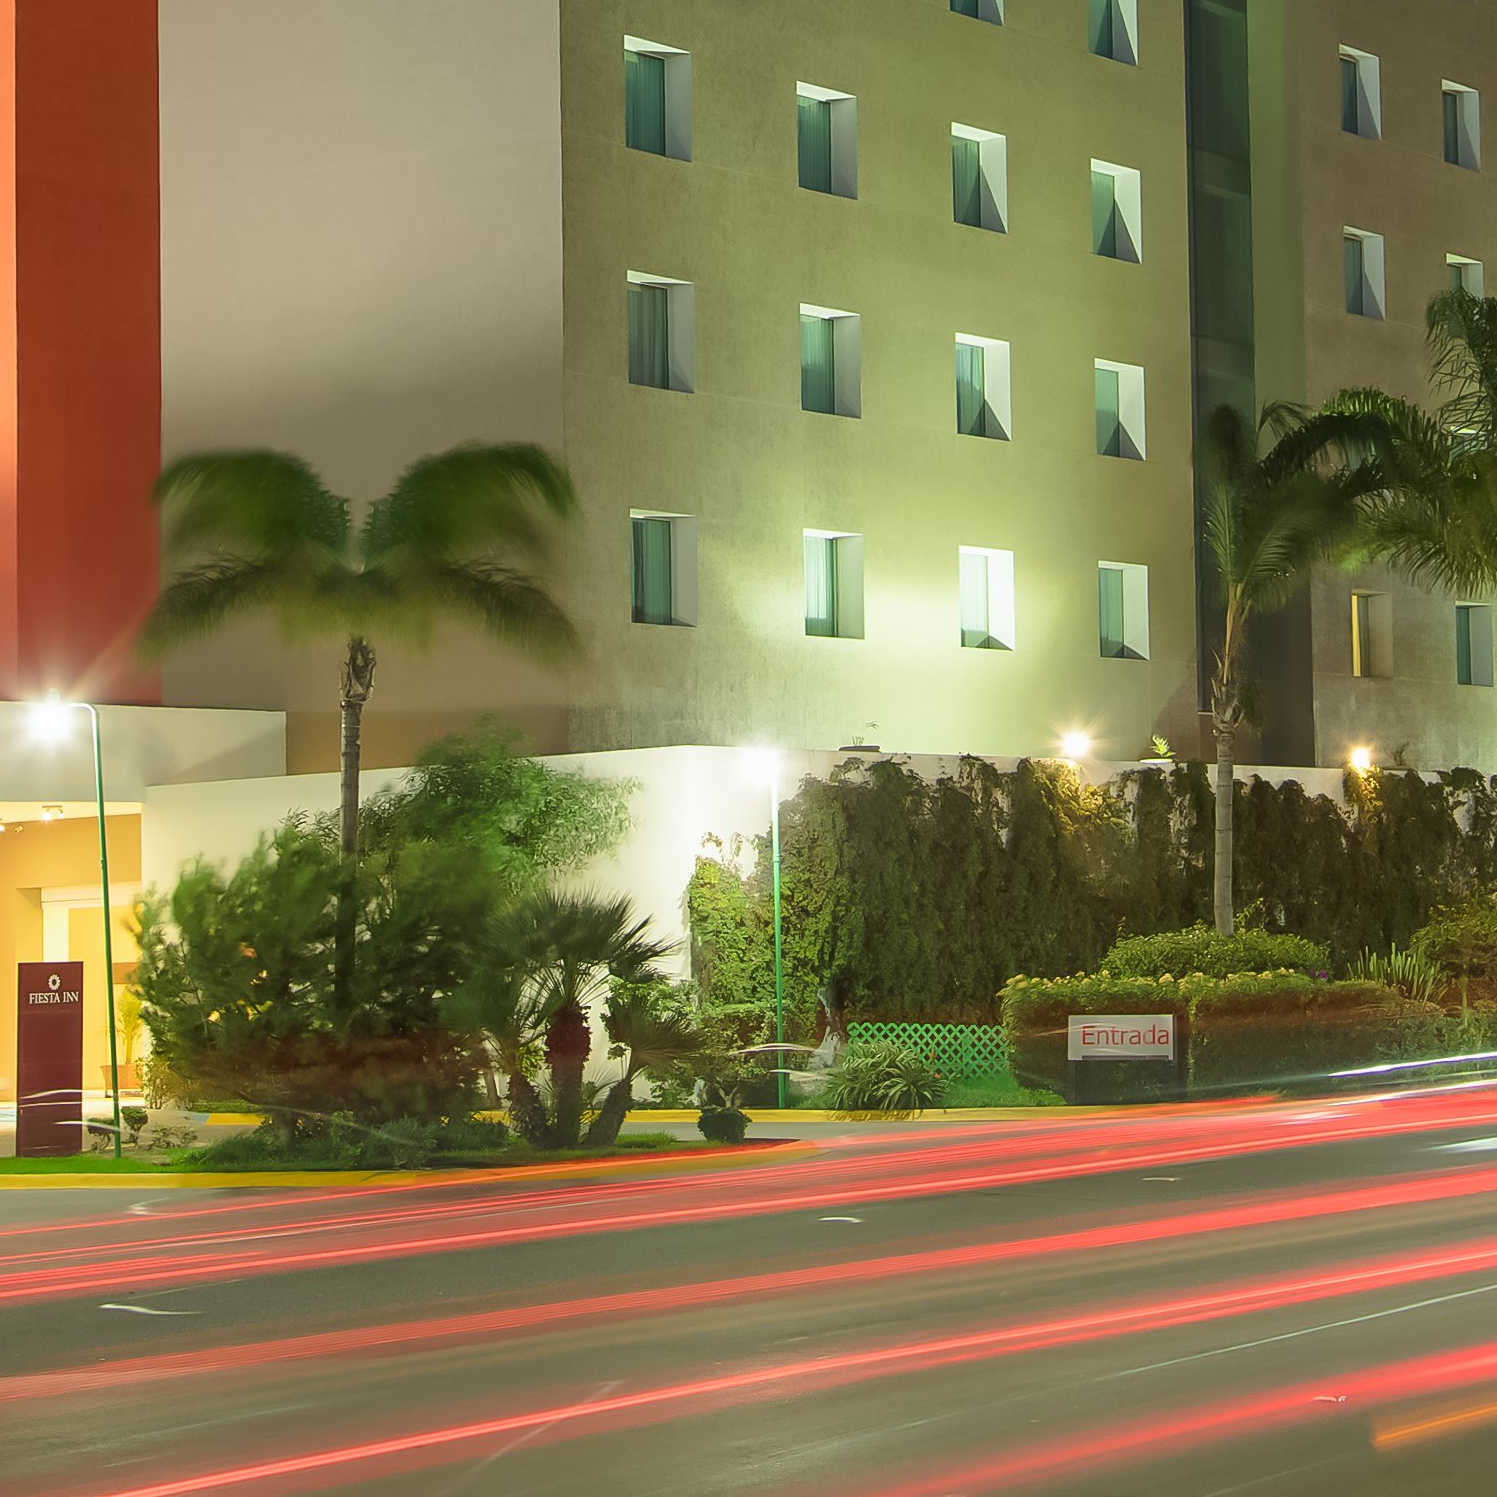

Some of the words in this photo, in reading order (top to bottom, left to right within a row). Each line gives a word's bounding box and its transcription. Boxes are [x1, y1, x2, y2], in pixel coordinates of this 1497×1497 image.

[29, 992, 60, 1004] FIESTA
[63, 992, 79, 1002] INN
[1082, 1024, 1169, 1045] Entrada
